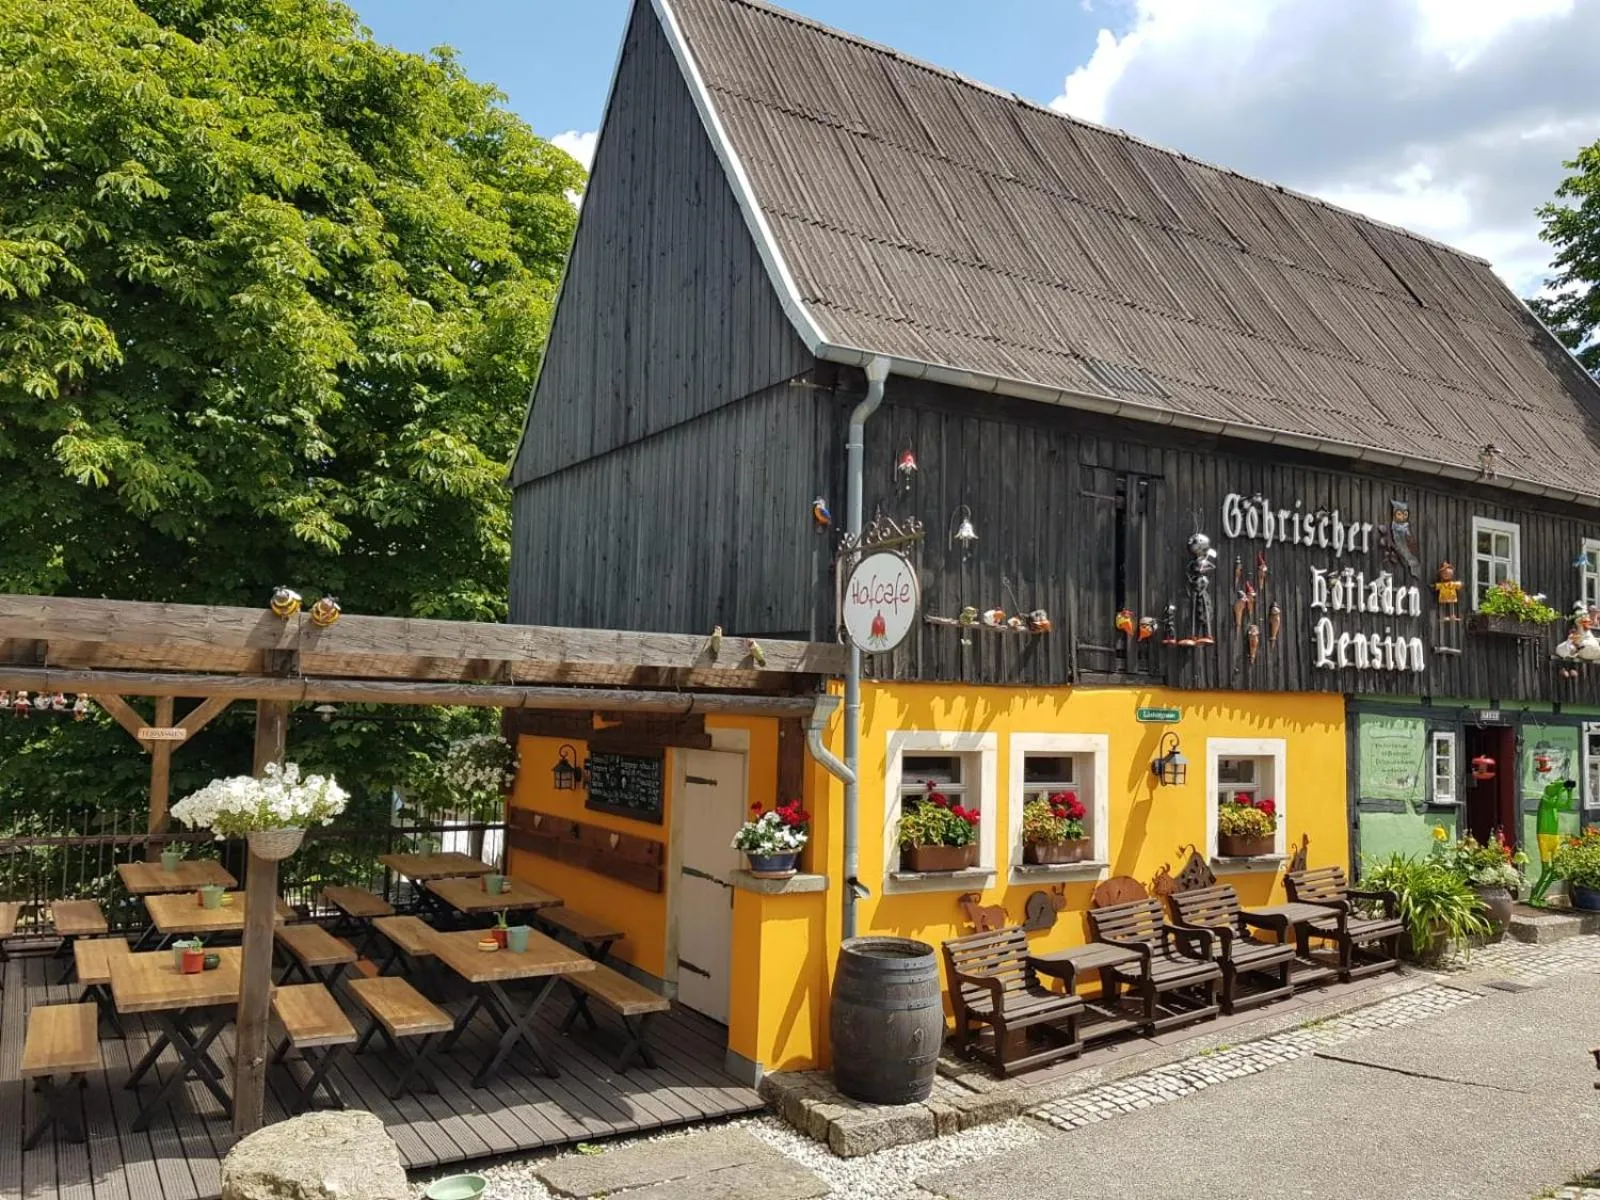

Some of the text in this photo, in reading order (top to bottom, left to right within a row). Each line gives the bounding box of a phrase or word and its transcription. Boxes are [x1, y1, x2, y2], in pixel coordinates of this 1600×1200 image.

[1222, 492, 1373, 557] Göhrischer
[851, 573, 911, 615] Hofcafe
[1311, 565, 1421, 616] Hofladen
[1314, 617, 1425, 672] Pension
